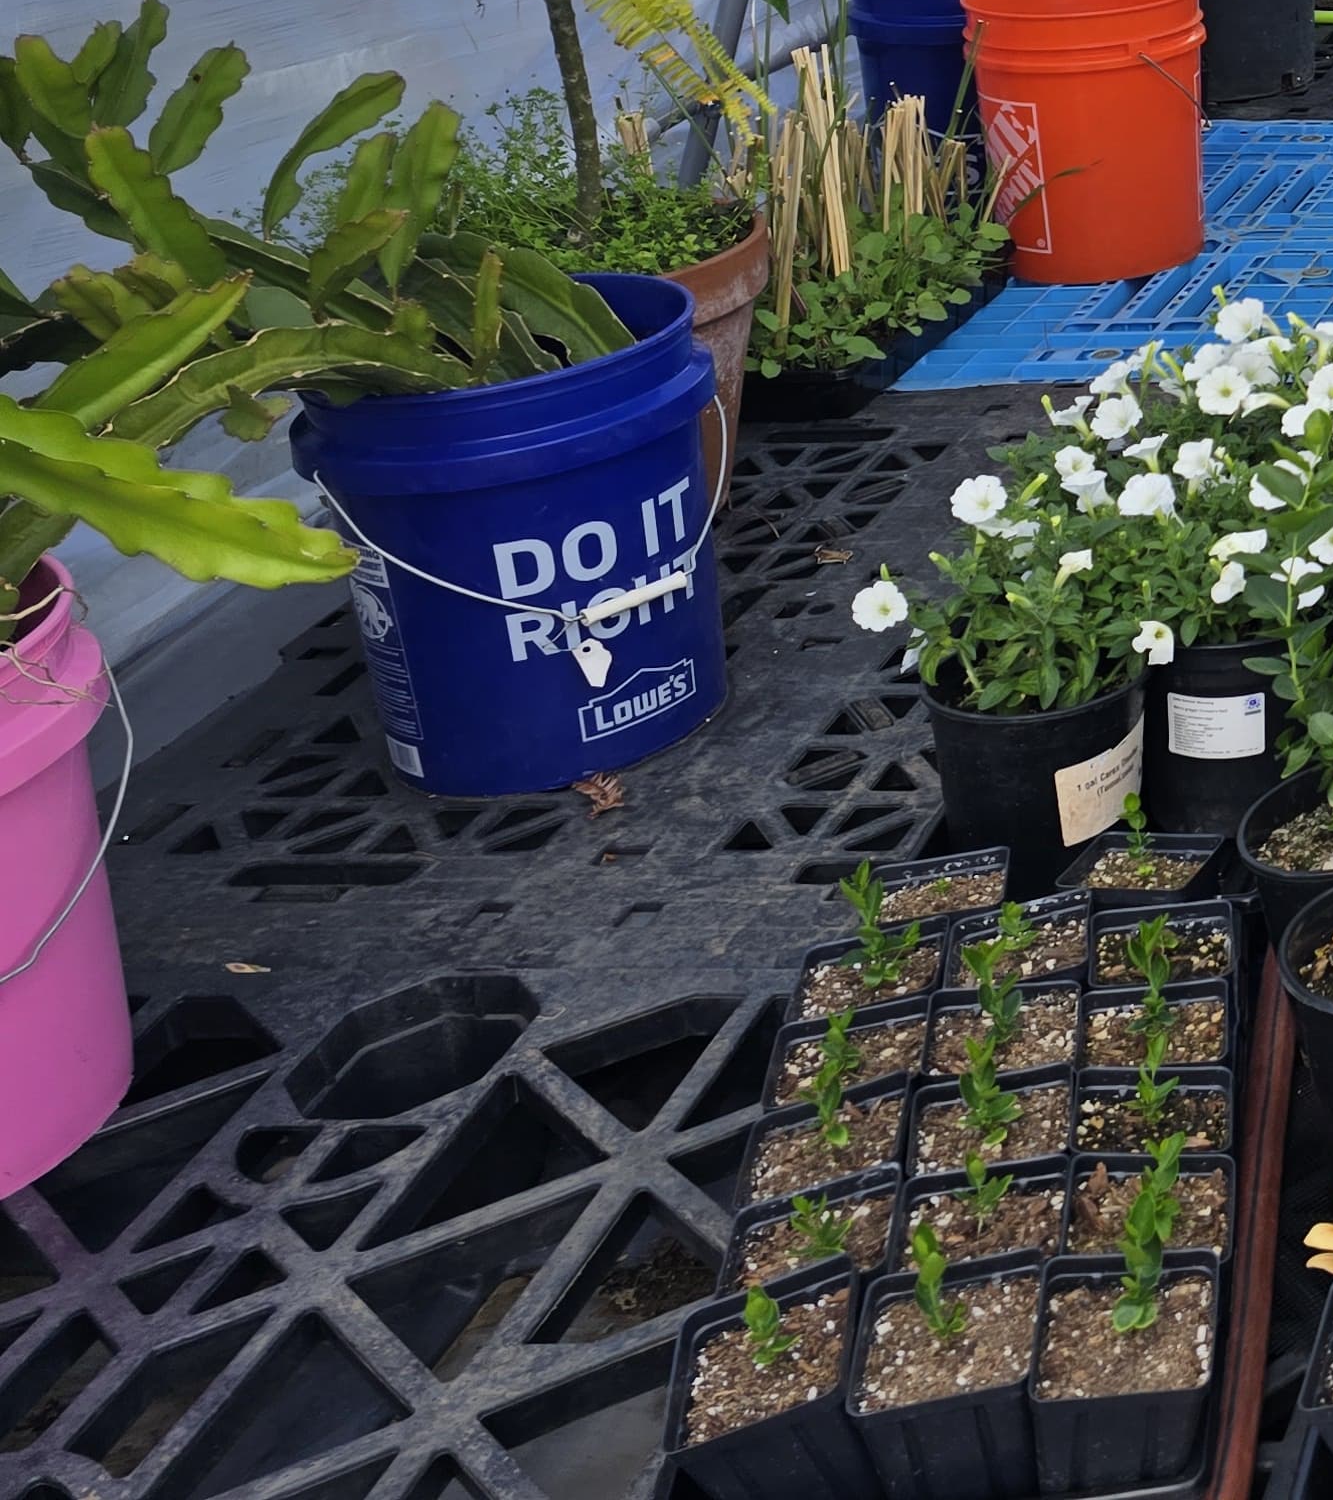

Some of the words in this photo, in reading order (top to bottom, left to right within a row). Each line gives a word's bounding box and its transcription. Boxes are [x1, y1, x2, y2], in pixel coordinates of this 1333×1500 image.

[493, 520, 618, 600] DO
[641, 476, 690, 558] IT
[594, 674, 688, 732] LOWE'S
